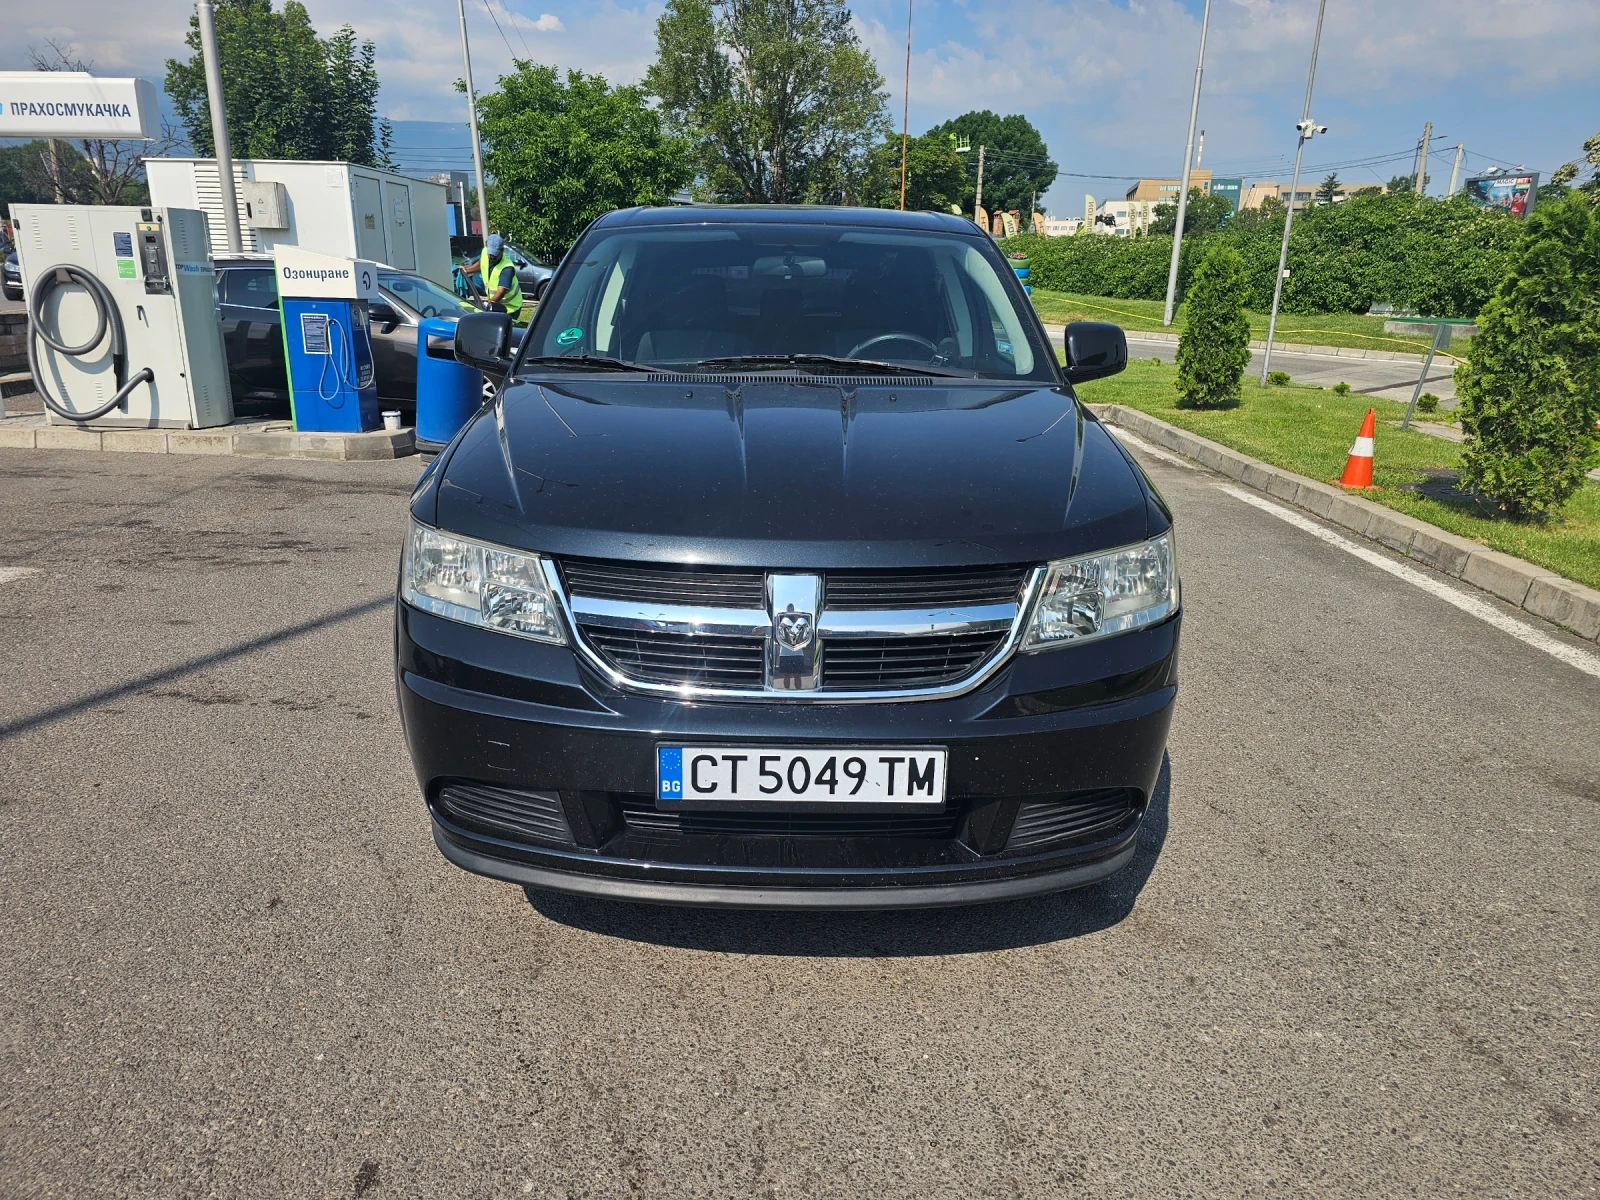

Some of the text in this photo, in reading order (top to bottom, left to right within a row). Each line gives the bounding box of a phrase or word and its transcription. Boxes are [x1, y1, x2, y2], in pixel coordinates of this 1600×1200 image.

[10, 102, 131, 117] ПРАХОСМУКАЧКА
[283, 266, 349, 282] Озониране
[566, 328, 574, 336] 4
[691, 754, 936, 796] CT 5049 TM
[662, 780, 681, 793] BG
